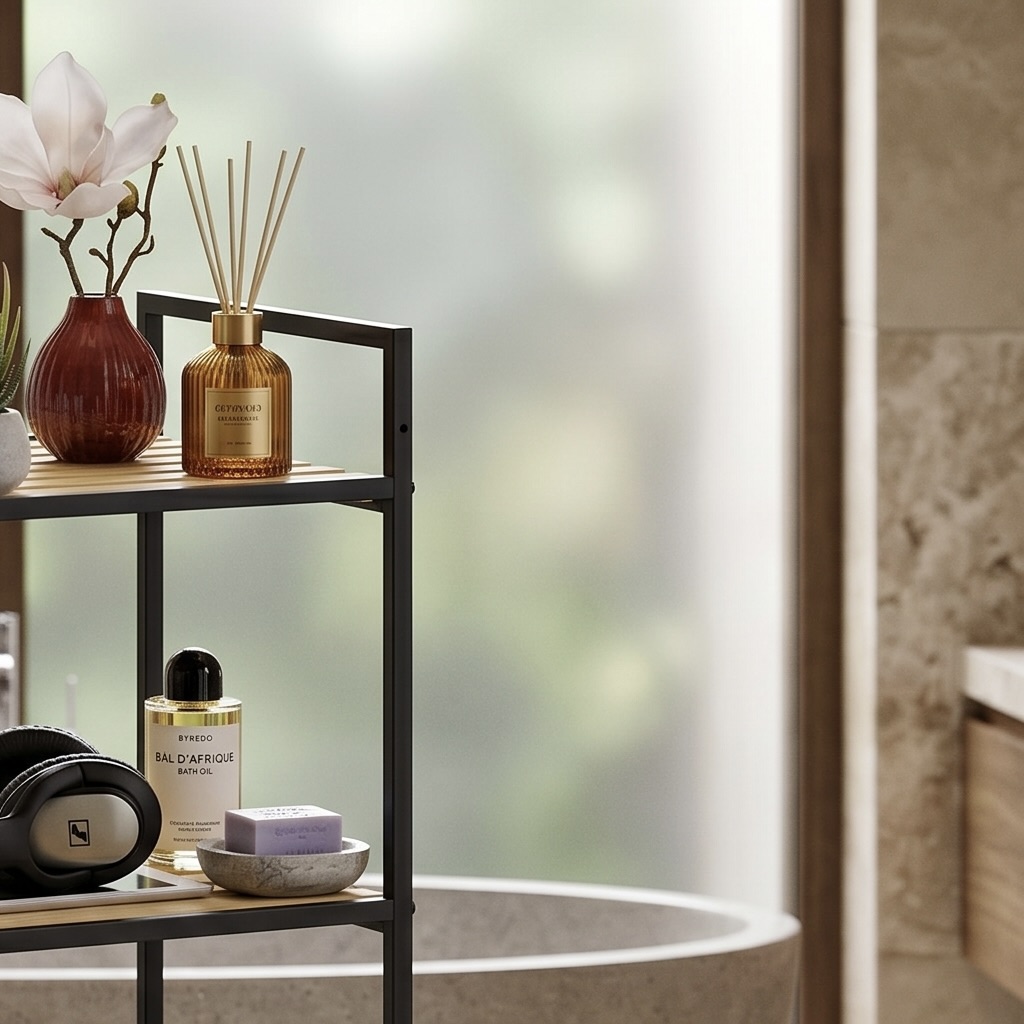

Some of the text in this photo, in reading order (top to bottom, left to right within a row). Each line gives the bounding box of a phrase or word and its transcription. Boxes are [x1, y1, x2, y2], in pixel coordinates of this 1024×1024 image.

[178, 734, 213, 742] BYREDO
[155, 751, 234, 764] BAL D'AFRIQUE
[177, 767, 213, 775] BATH OIL
